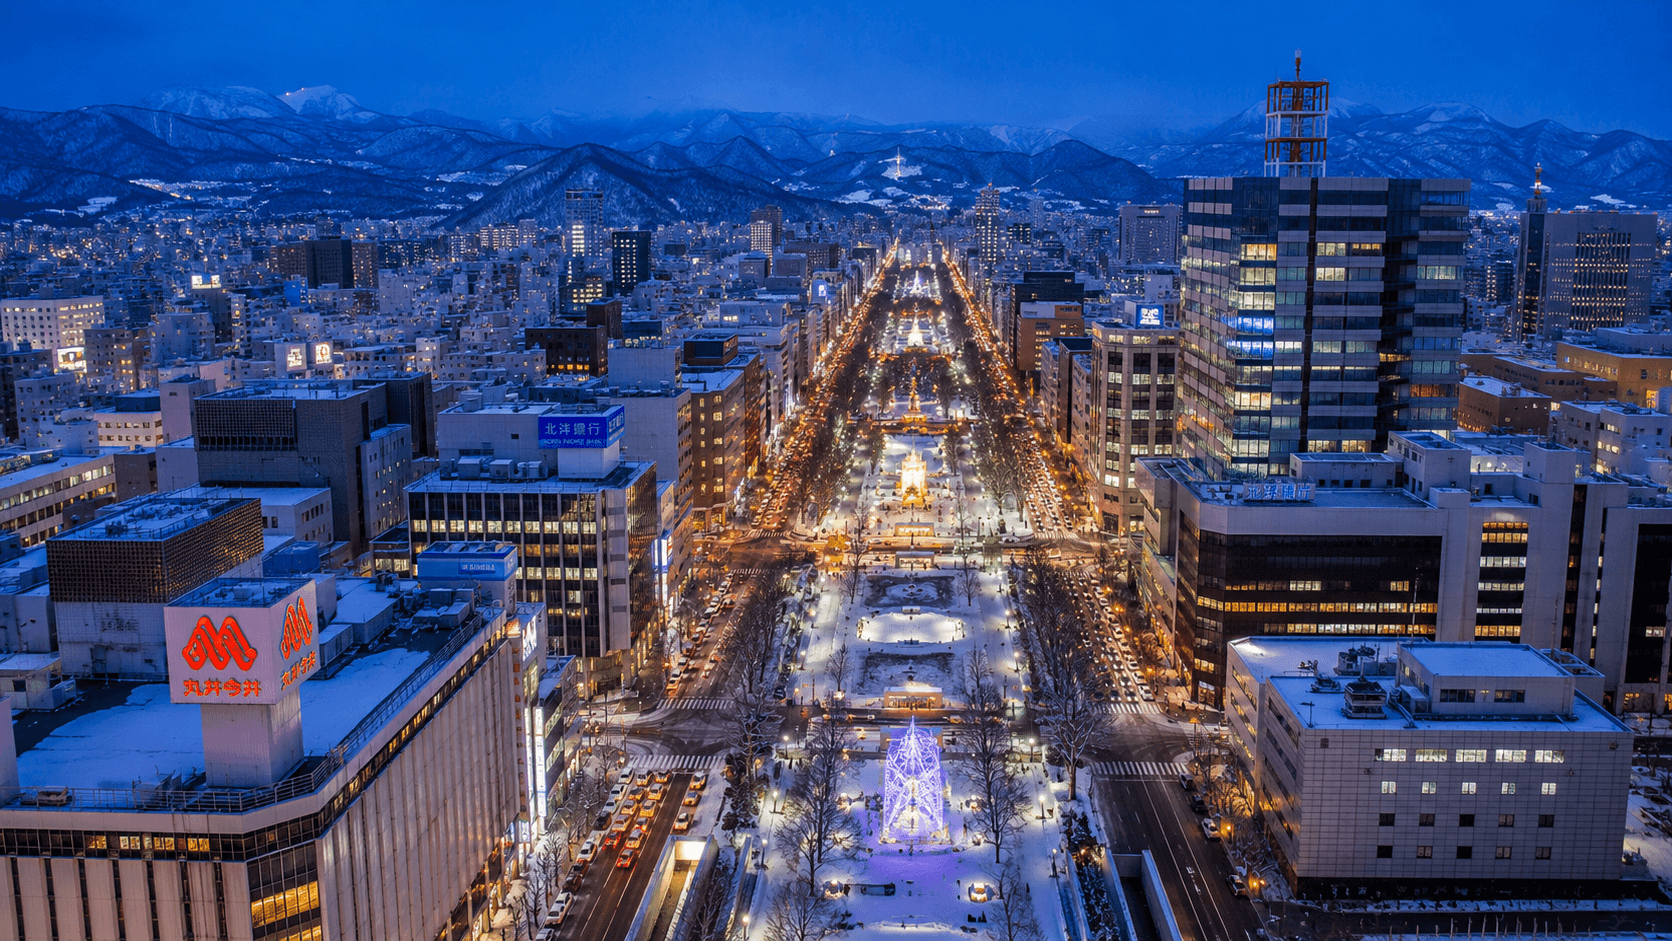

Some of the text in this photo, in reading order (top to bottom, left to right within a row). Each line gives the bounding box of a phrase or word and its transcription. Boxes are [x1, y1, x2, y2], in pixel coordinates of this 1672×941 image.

[545, 422, 601, 436] 北洋銀行
[183, 678, 262, 697] 丸井今井
